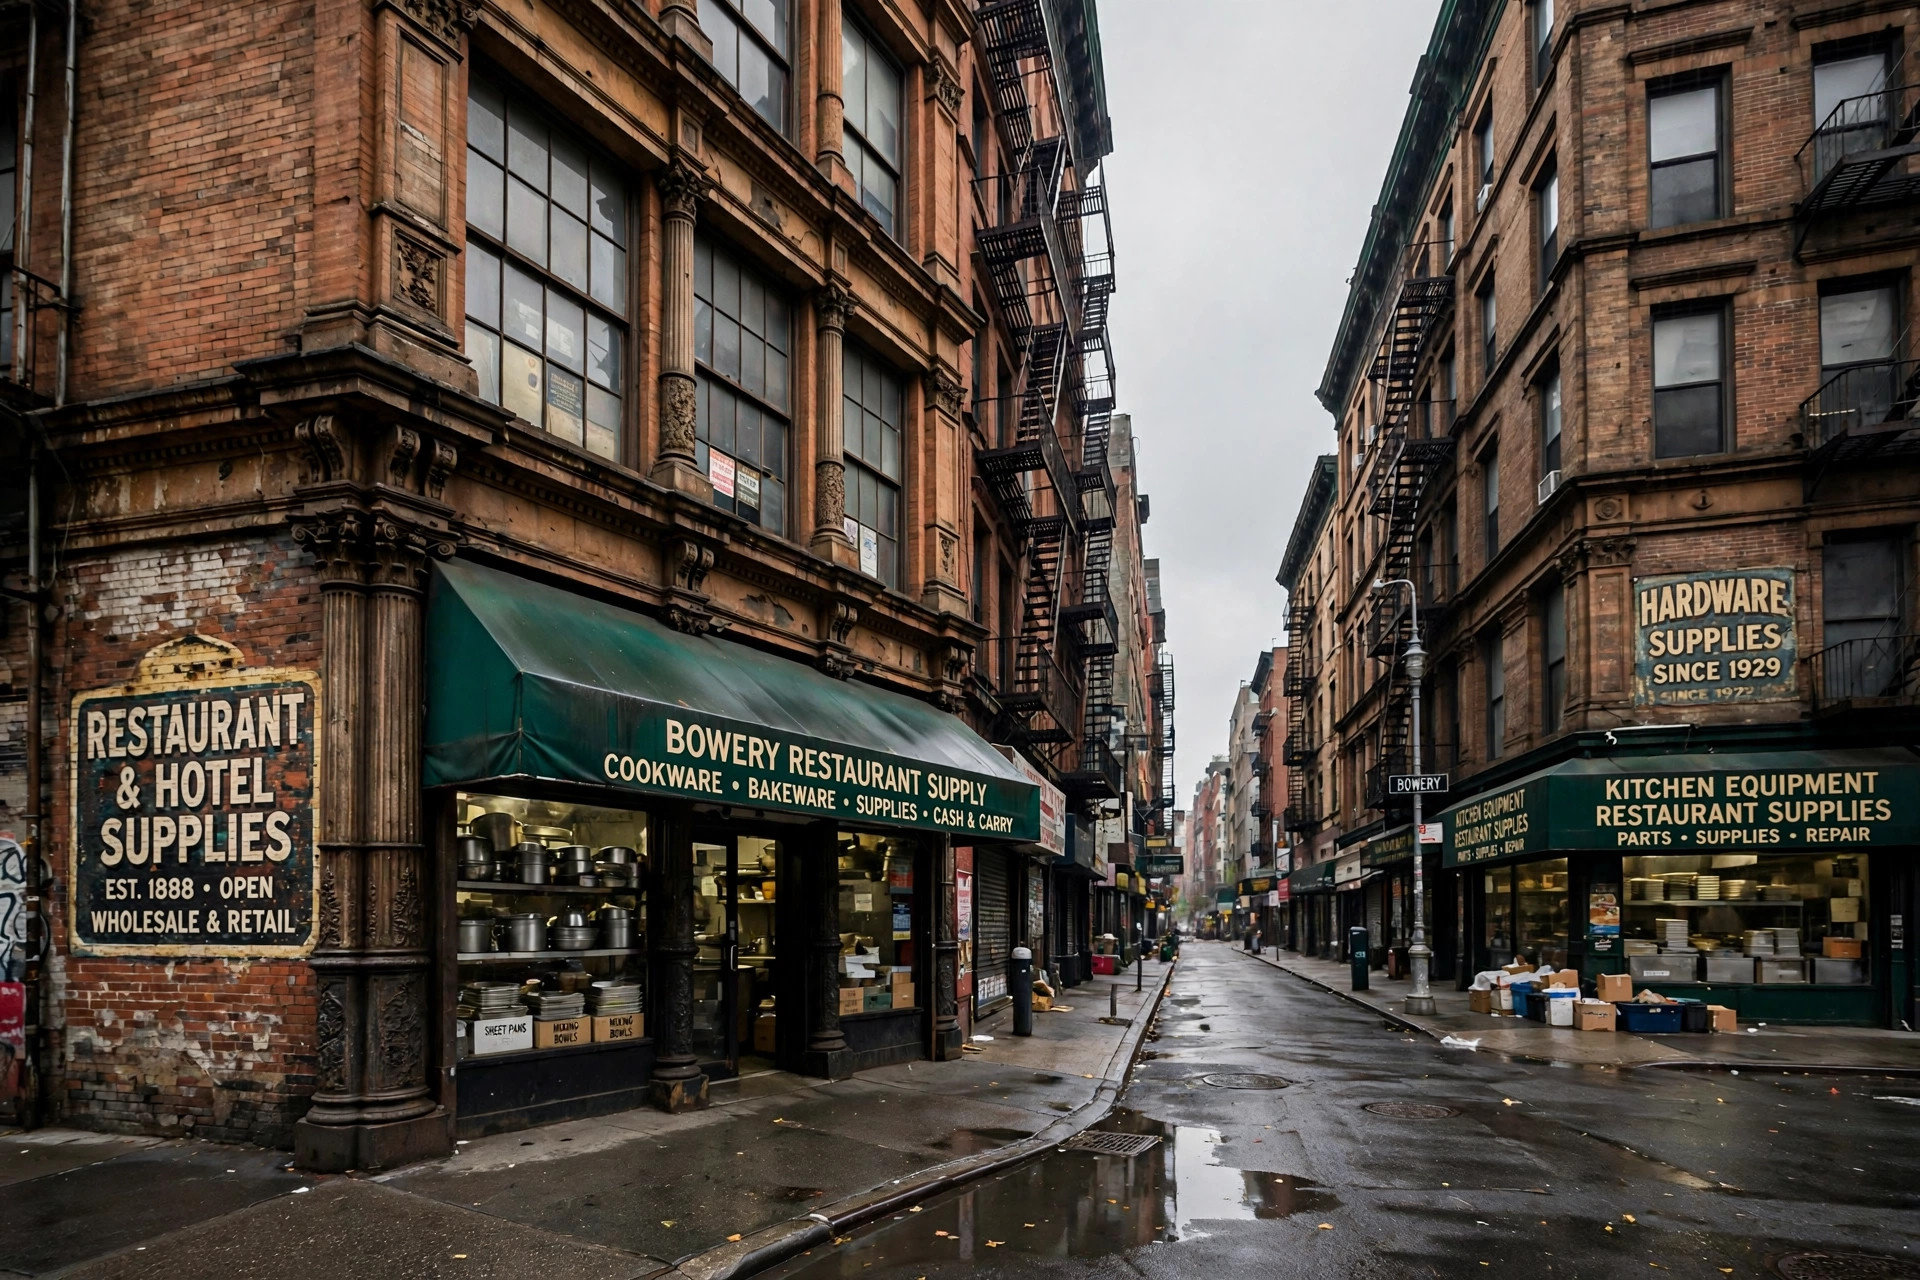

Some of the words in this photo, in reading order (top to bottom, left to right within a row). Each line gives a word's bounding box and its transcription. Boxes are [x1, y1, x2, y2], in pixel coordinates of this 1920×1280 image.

[1641, 579, 1787, 627] HARDWARE
[1649, 624, 1782, 657] SUPPLIES
[1653, 661, 1720, 684] SINCE
[1729, 657, 1781, 679] 1929
[87, 693, 304, 760] RESTAURANT
[666, 719, 780, 771] BOWERY
[789, 744, 921, 795] RESTAURANT
[927, 773, 987, 806] SUPPLY
[116, 766, 140, 810] &
[155, 757, 274, 808] HOTEL
[604, 753, 723, 794] COOKWARE
[748, 777, 836, 810] BAKEWARE
[856, 795, 917, 821] SUPPLIES
[933, 807, 963, 828] CASH
[967, 814, 975, 828] &
[979, 814, 1013, 833] CARRY
[1397, 777, 1441, 791] BOWERY
[1605, 776, 1714, 800] KITCHEN
[1726, 772, 1879, 798] EQUIPMENT
[1483, 789, 1525, 819] EQUIPMENT
[1596, 802, 1758, 827] RESTAURANT
[1768, 799, 1891, 823] SUPPLIES
[100, 811, 291, 867] SUPPLIES
[1455, 823, 1492, 848] RESTAURANT
[1494, 813, 1528, 840] SUPPLIES
[1617, 831, 1672, 846] PARTS
[1696, 829, 1781, 845] SUPPLIES
[1806, 827, 1871, 842] REPAIR
[105, 877, 142, 900] EST.
[148, 877, 194, 899] 1888
[219, 876, 273, 899] OPEN
[91, 910, 199, 934] WHOLESALE
[206, 910, 220, 933] &
[227, 909, 296, 933] RETAIL
[509, 1023, 527, 1035] PANS
